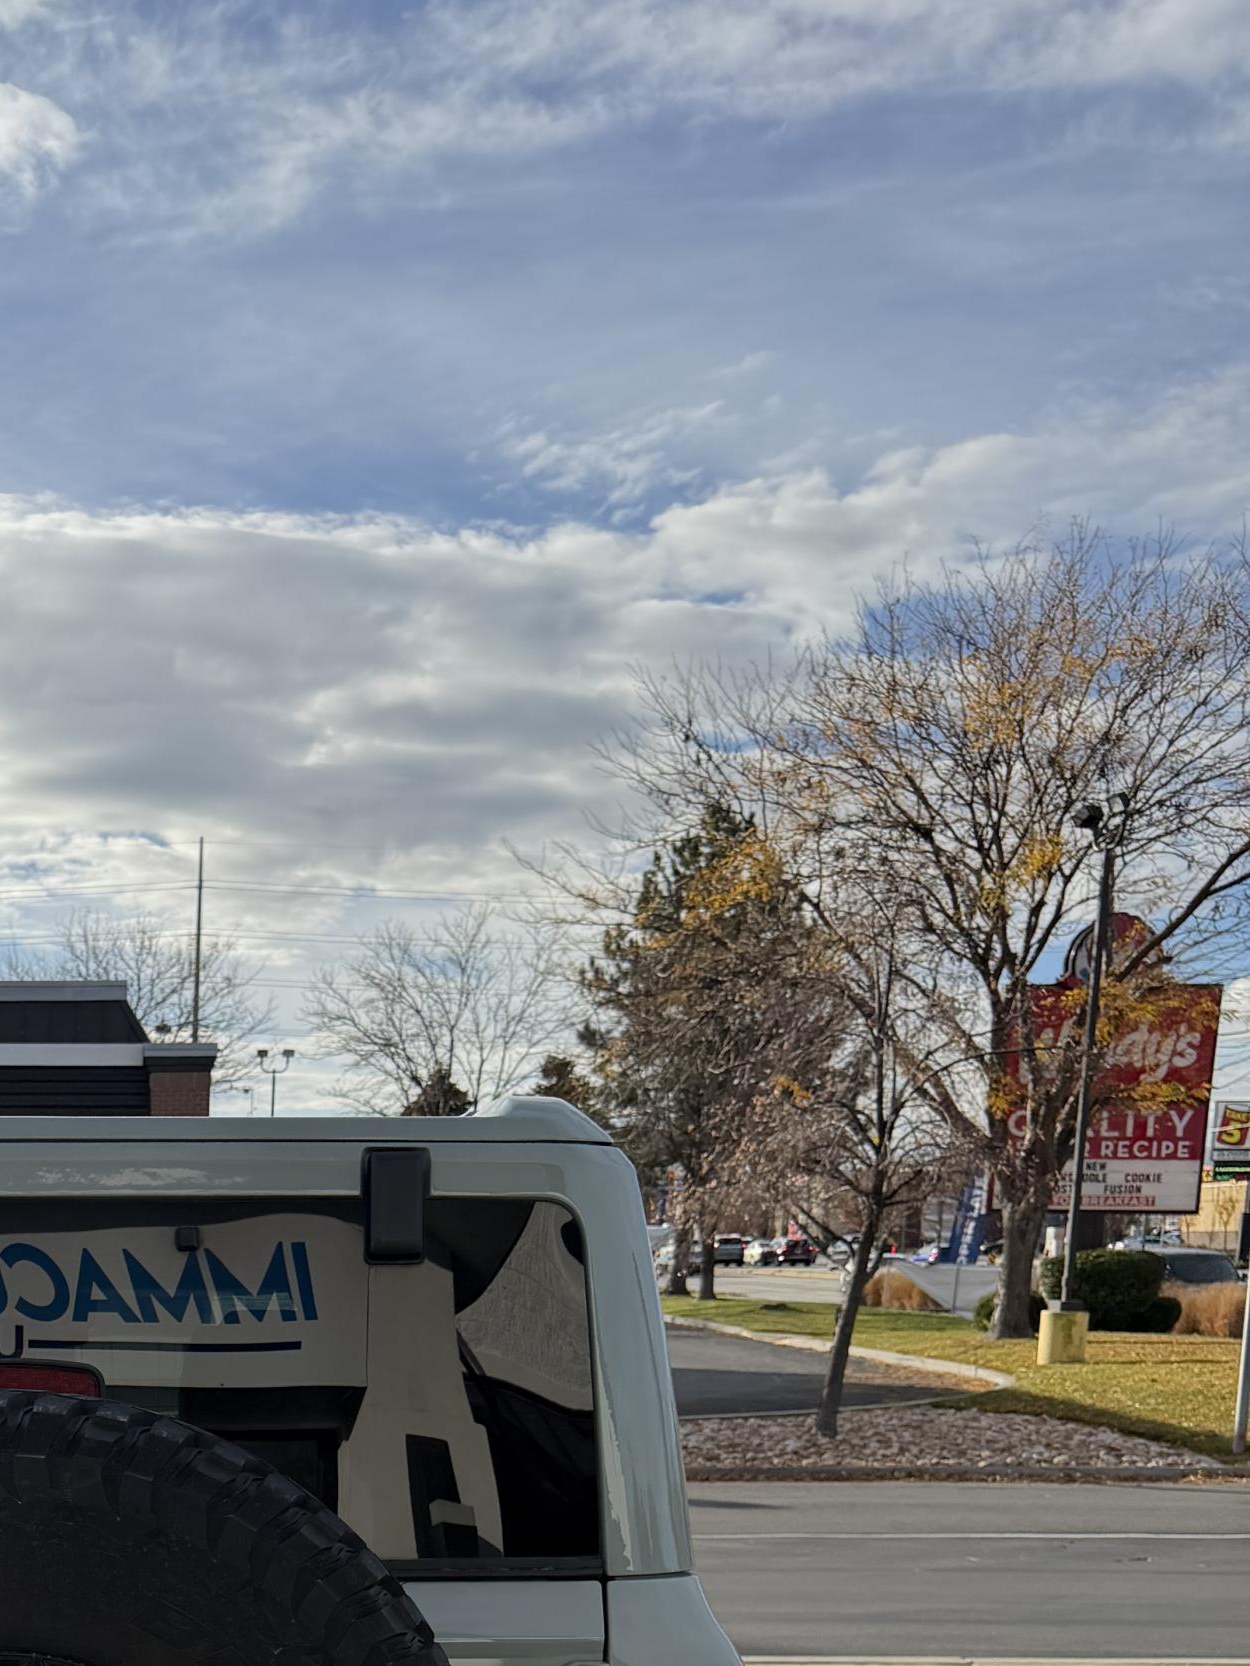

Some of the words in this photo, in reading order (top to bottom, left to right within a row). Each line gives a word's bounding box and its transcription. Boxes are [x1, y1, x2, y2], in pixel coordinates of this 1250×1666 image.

[1101, 1141, 1190, 1158] RECIPE
[1085, 1162, 1107, 1171] NEW
[1124, 1173, 1163, 1183] COOKIE
[1103, 1184, 1142, 1194] FUSION
